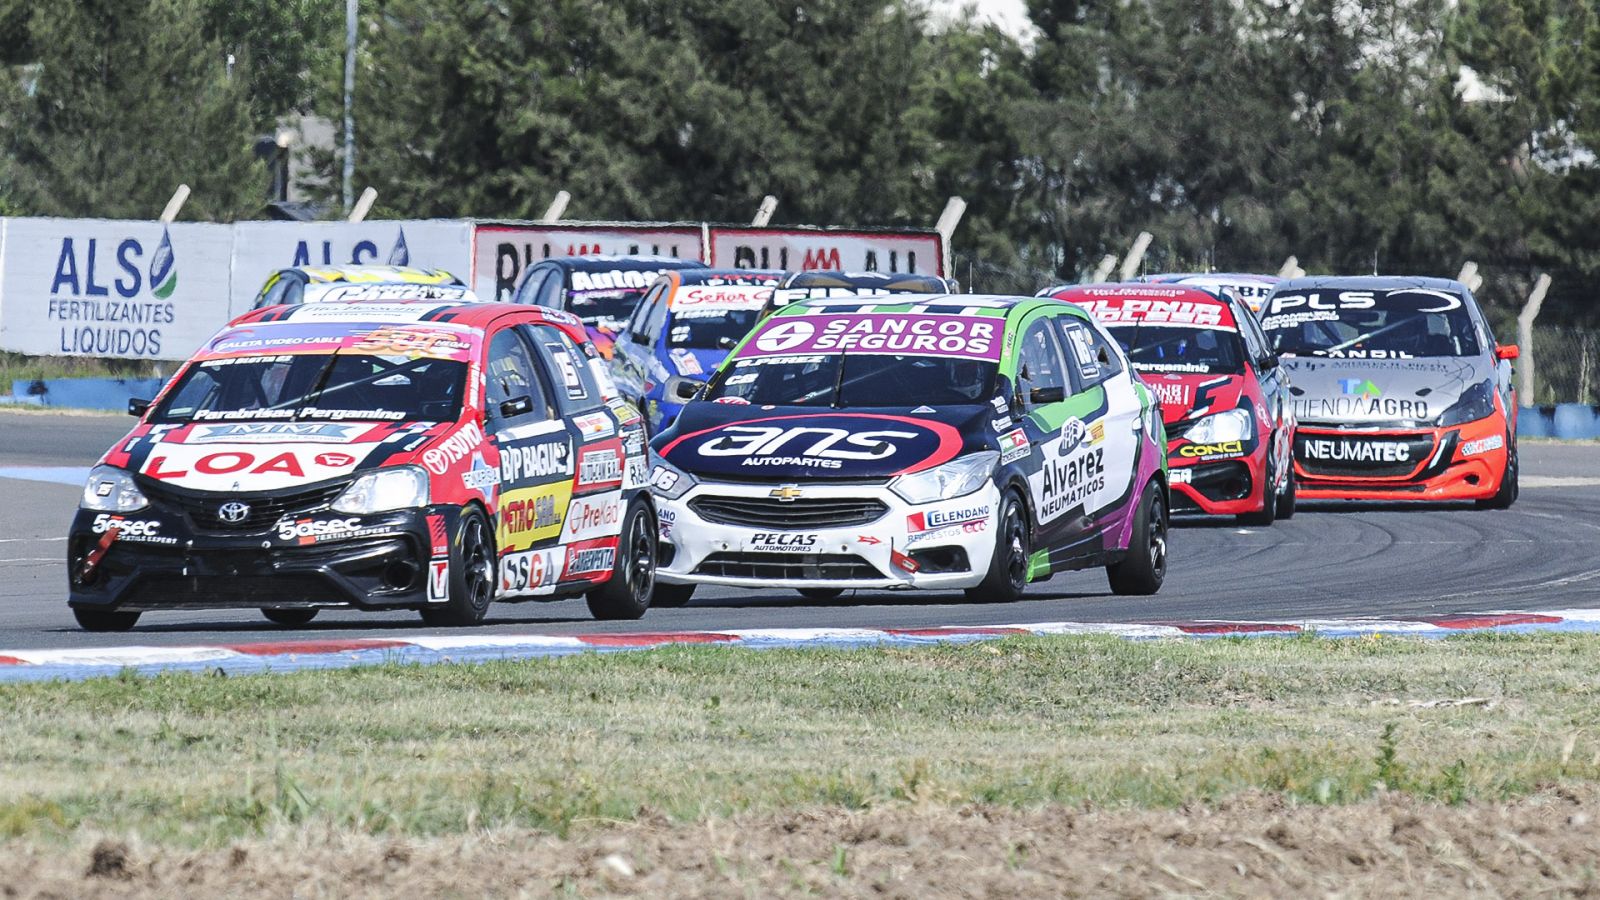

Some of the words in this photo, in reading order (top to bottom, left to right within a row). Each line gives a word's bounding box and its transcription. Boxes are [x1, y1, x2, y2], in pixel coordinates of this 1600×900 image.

[51, 238, 143, 298] ALS
[679, 290, 746, 305] Señor
[1271, 291, 1376, 313] PLS
[48, 299, 174, 325] FERTILIZANTES
[822, 318, 995, 339] SANCOR
[60, 328, 161, 355] LIQUIDOS
[265, 336, 302, 346] VIDEO
[303, 336, 344, 345] CABLE
[812, 333, 990, 353] SEGUROS
[193, 409, 296, 421] Parabrisas
[300, 408, 406, 423] Pergamino
[228, 423, 319, 435] MM
[698, 426, 918, 457] ans
[1179, 440, 1243, 458] CONCI
[1304, 440, 1410, 462] NEUMATEC
[143, 451, 305, 479] LOA
[742, 456, 842, 469] AUTOPARTES
[1042, 447, 1104, 501] Alvarez
[1041, 476, 1105, 520] NEUMATICOS
[750, 533, 819, 546] PECAS
